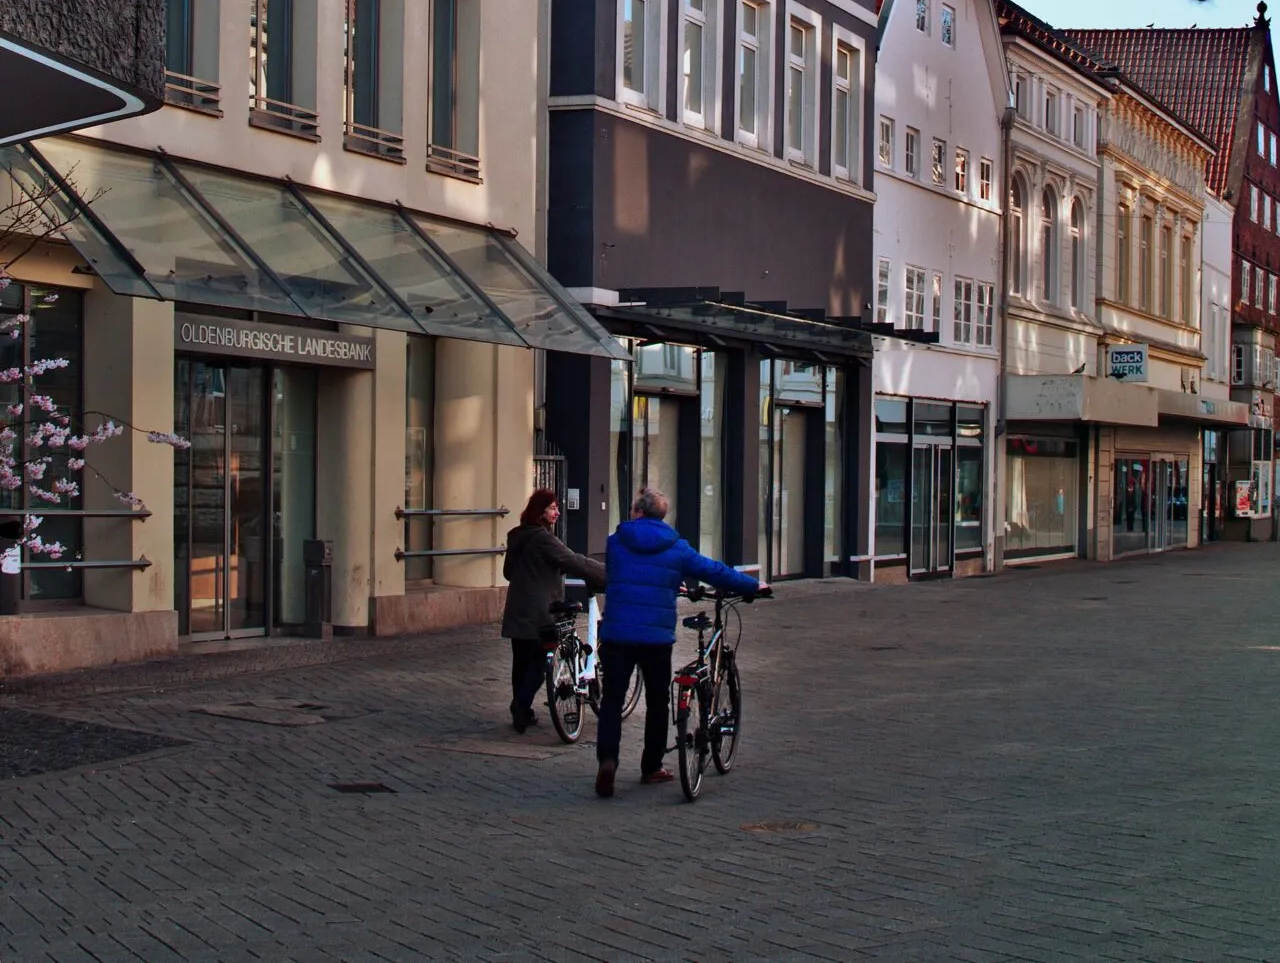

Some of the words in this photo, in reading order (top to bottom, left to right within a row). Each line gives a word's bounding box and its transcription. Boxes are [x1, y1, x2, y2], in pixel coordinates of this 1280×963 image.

[181, 323, 295, 354] OLDENBURGISCHE
[297, 337, 373, 362] LANDESBANK
[1112, 352, 1142, 363] back
[1112, 365, 1143, 375] WERK
